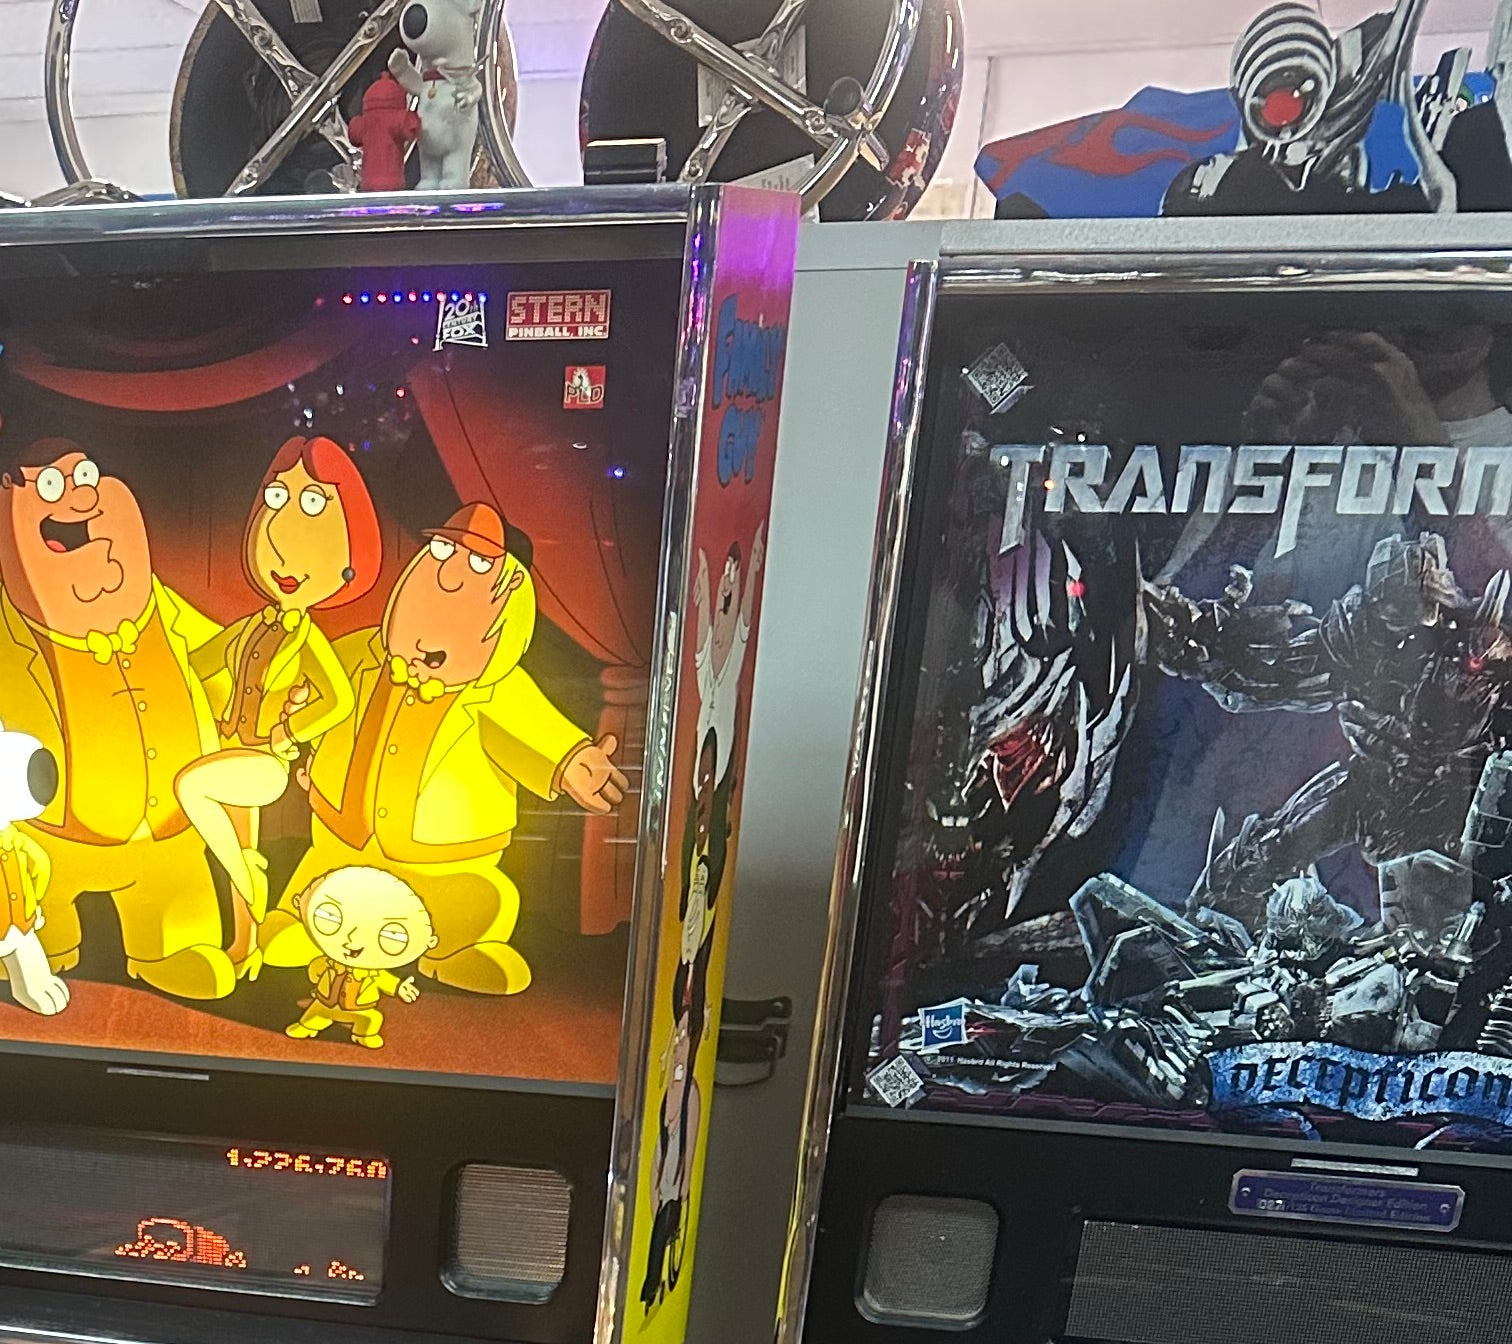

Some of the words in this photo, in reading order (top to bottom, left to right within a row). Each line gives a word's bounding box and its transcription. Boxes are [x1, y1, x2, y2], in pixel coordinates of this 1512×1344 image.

[443, 325, 477, 341] FOX
[511, 294, 606, 324] STERN
[713, 294, 786, 409] FAMILY
[717, 403, 765, 488] GUY
[990, 444, 1512, 558] TRANSFORM
